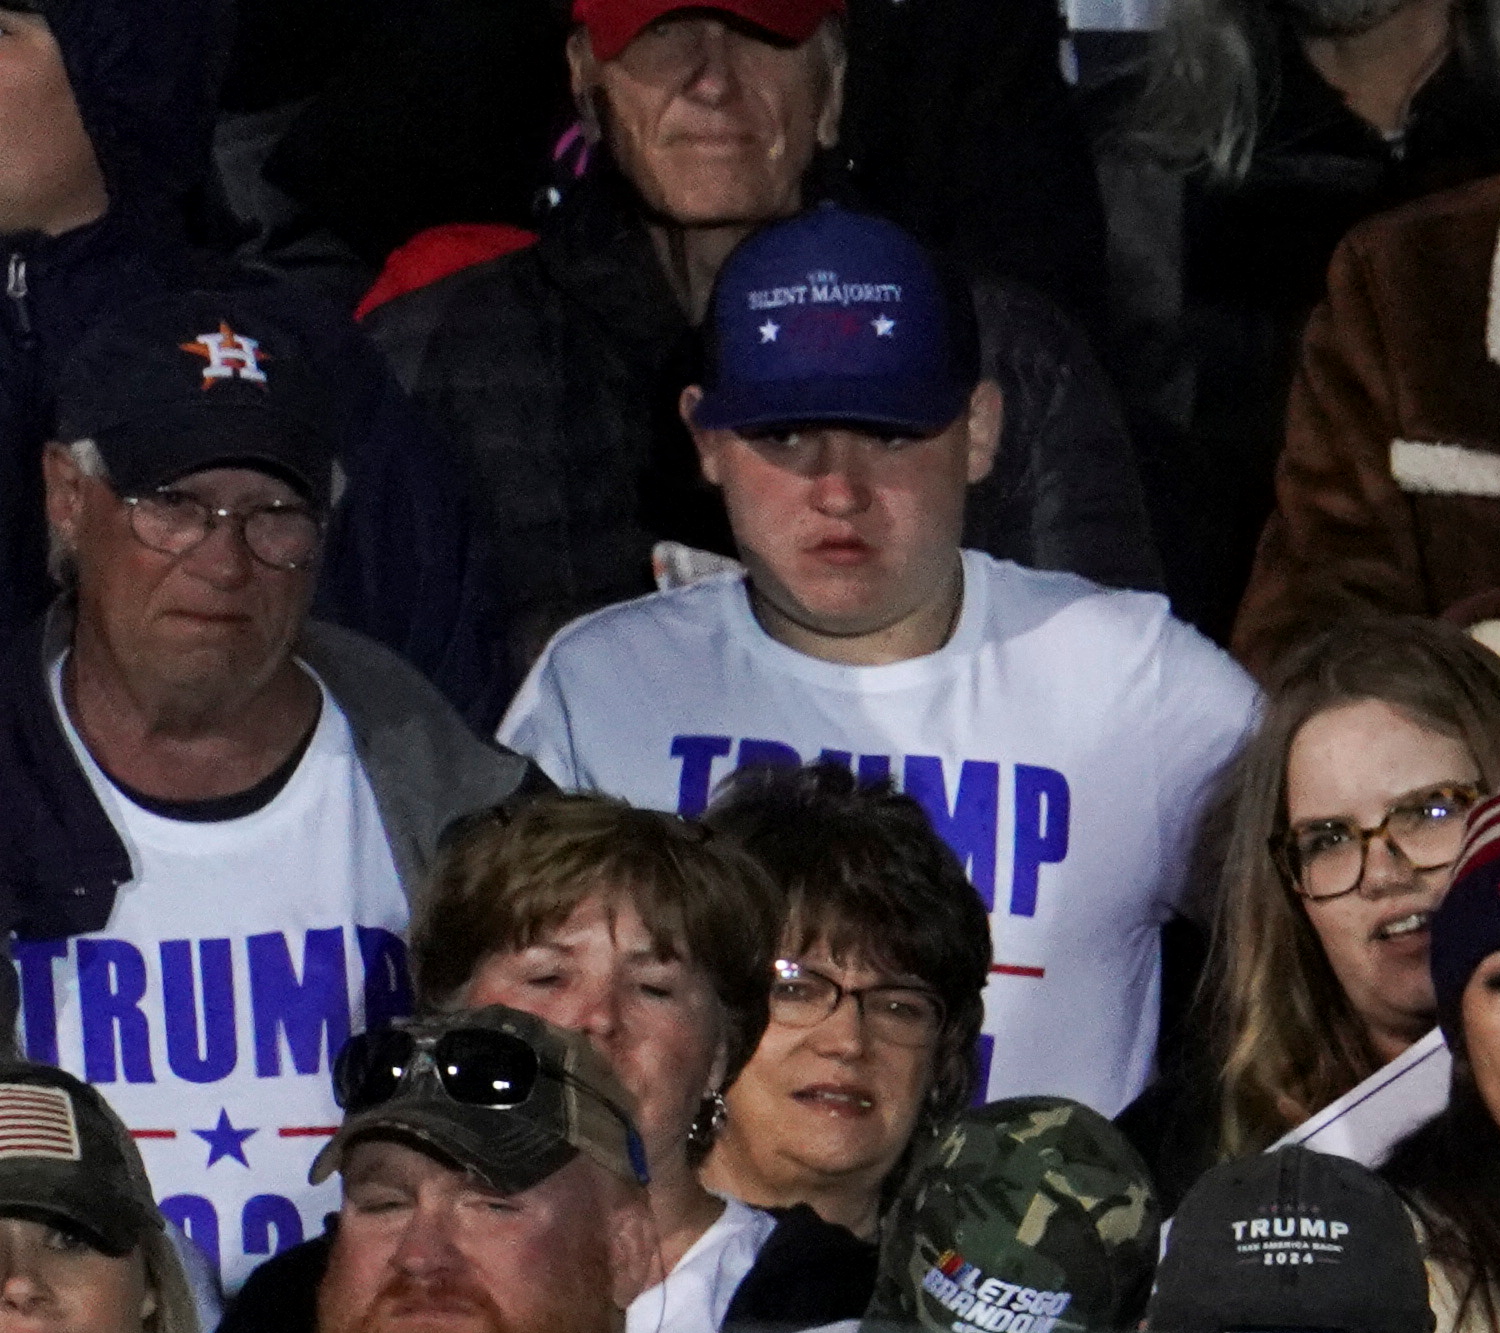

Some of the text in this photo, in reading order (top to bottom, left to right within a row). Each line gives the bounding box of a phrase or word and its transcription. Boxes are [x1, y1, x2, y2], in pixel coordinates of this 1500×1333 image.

[811, 284, 902, 306] MAJORITY
[1231, 1216, 1349, 1241] TRUMP
[1264, 1251, 1314, 1265] 2024
